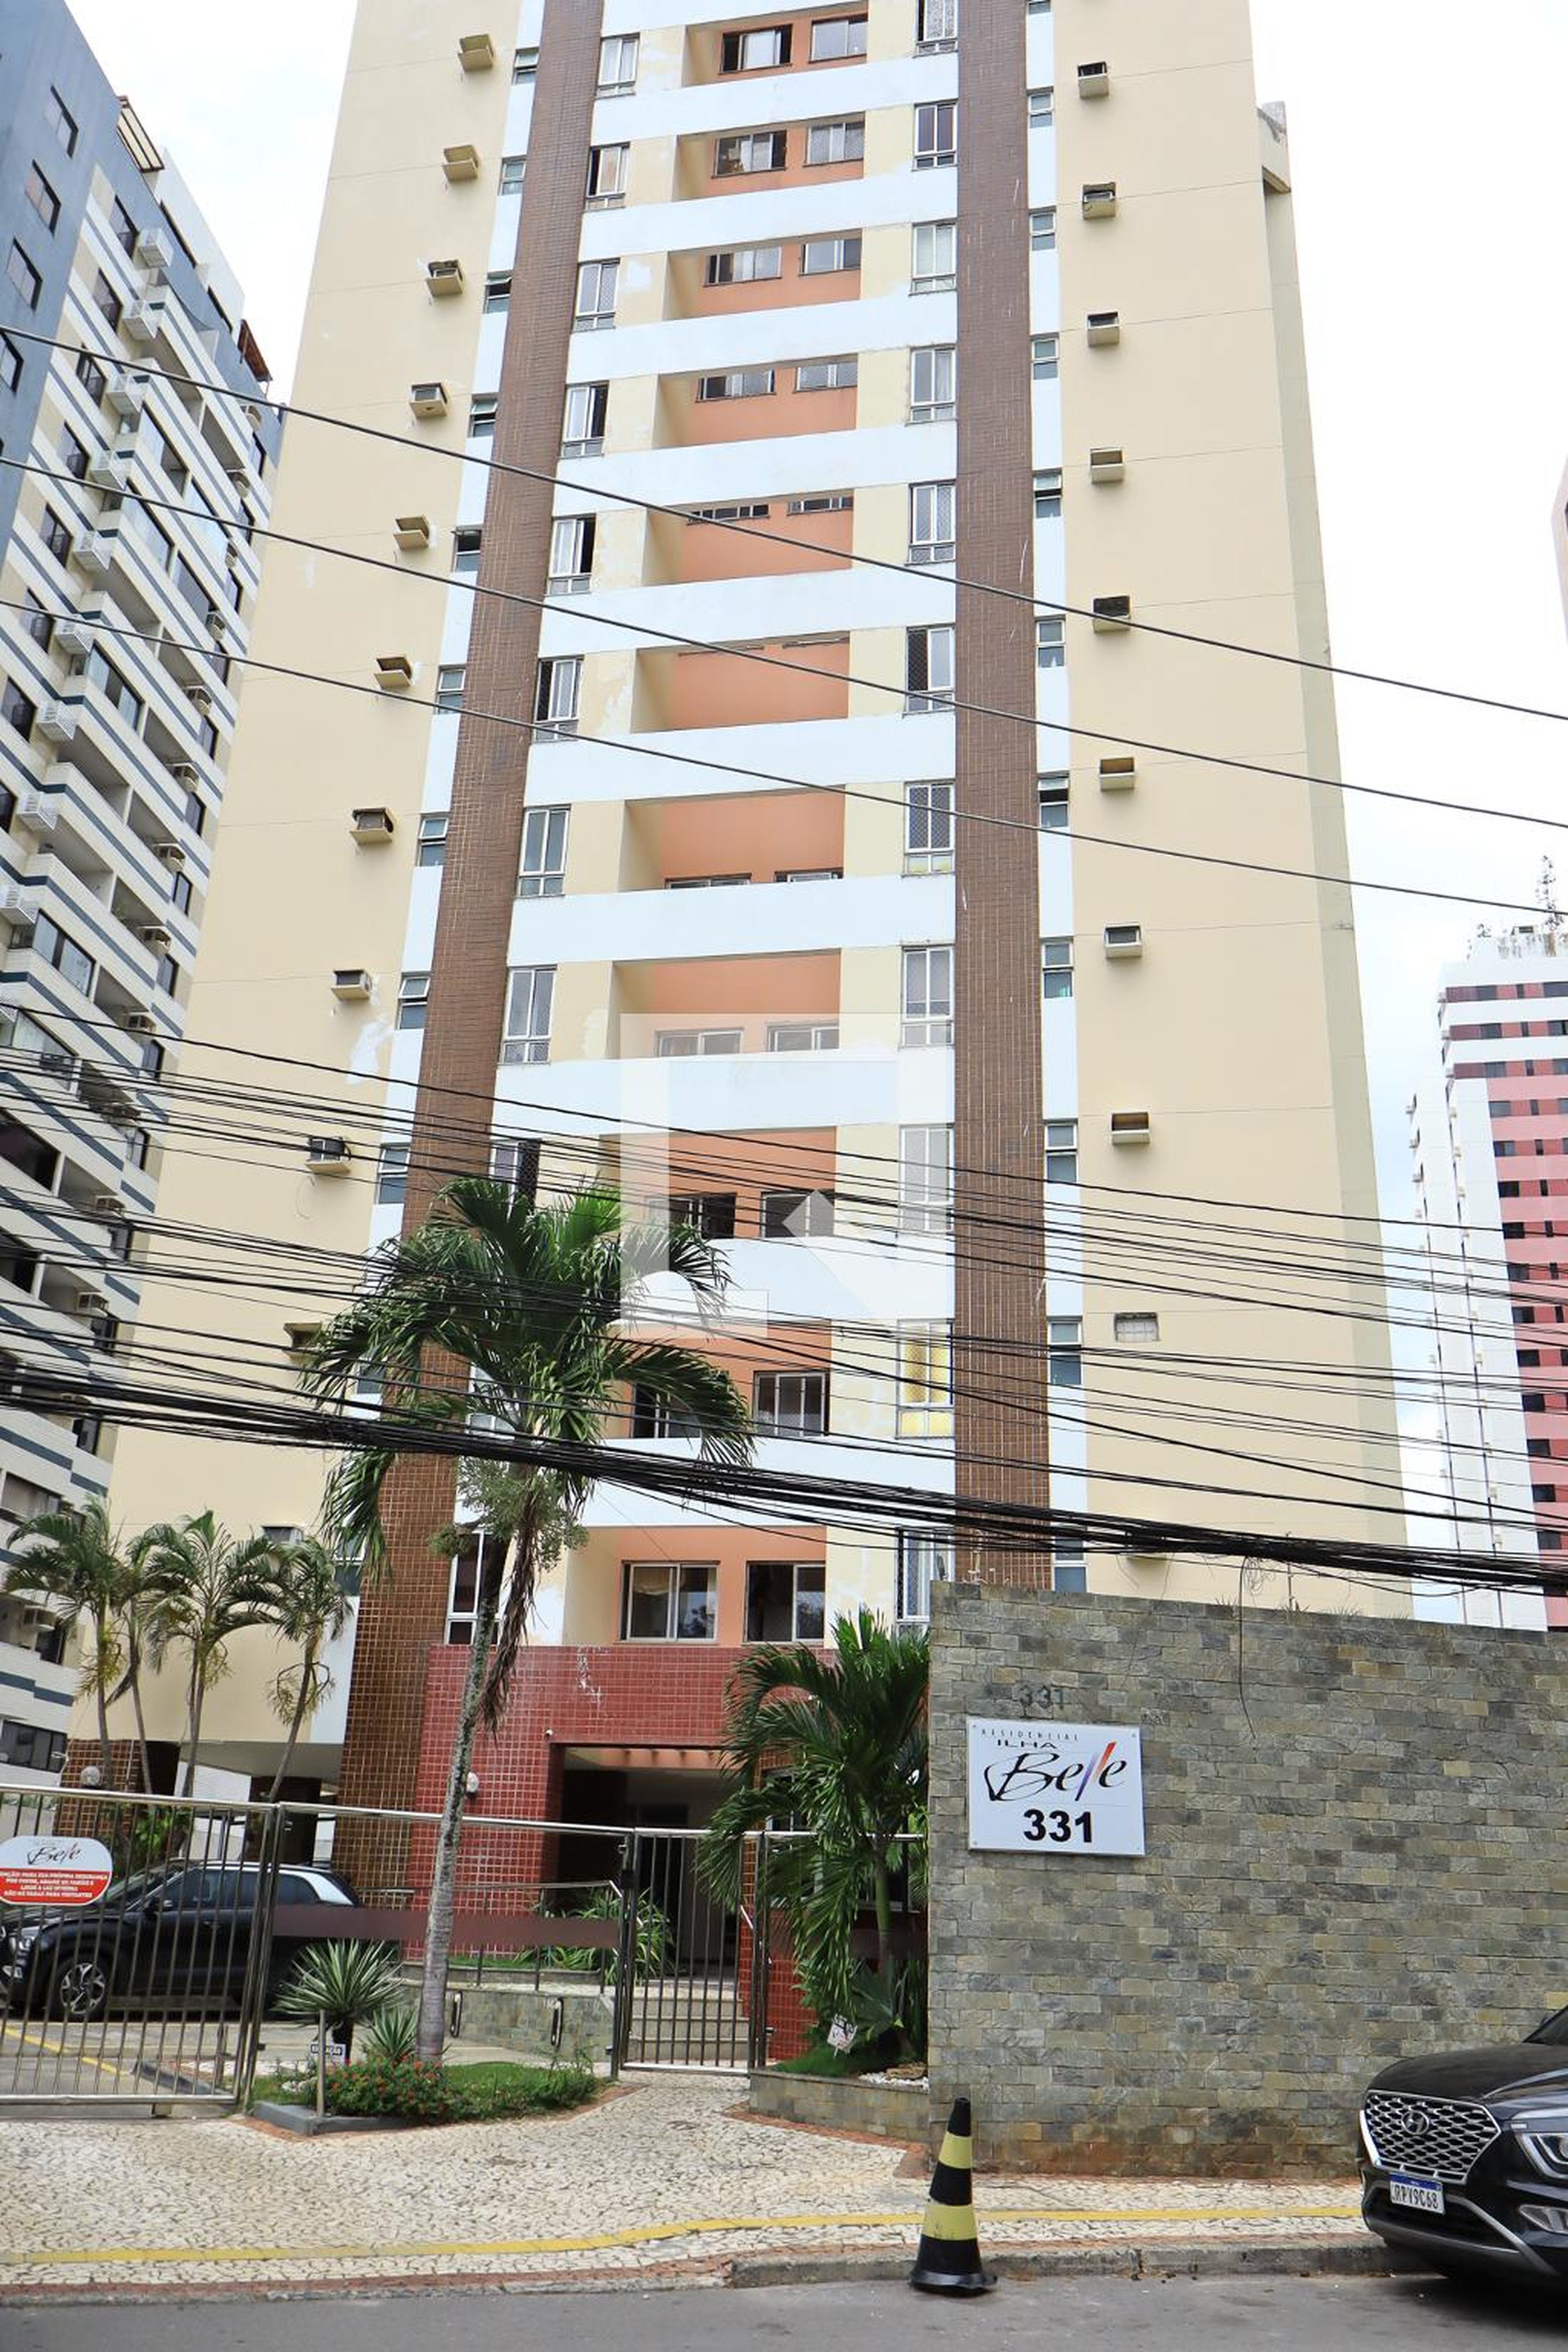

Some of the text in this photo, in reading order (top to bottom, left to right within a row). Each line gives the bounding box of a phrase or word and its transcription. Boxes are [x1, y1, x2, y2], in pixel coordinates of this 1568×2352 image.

[982, 1728, 1078, 1741] RESIDENCIAL
[998, 1739, 1057, 1749] ILHA
[1023, 1809, 1093, 1843] 331
